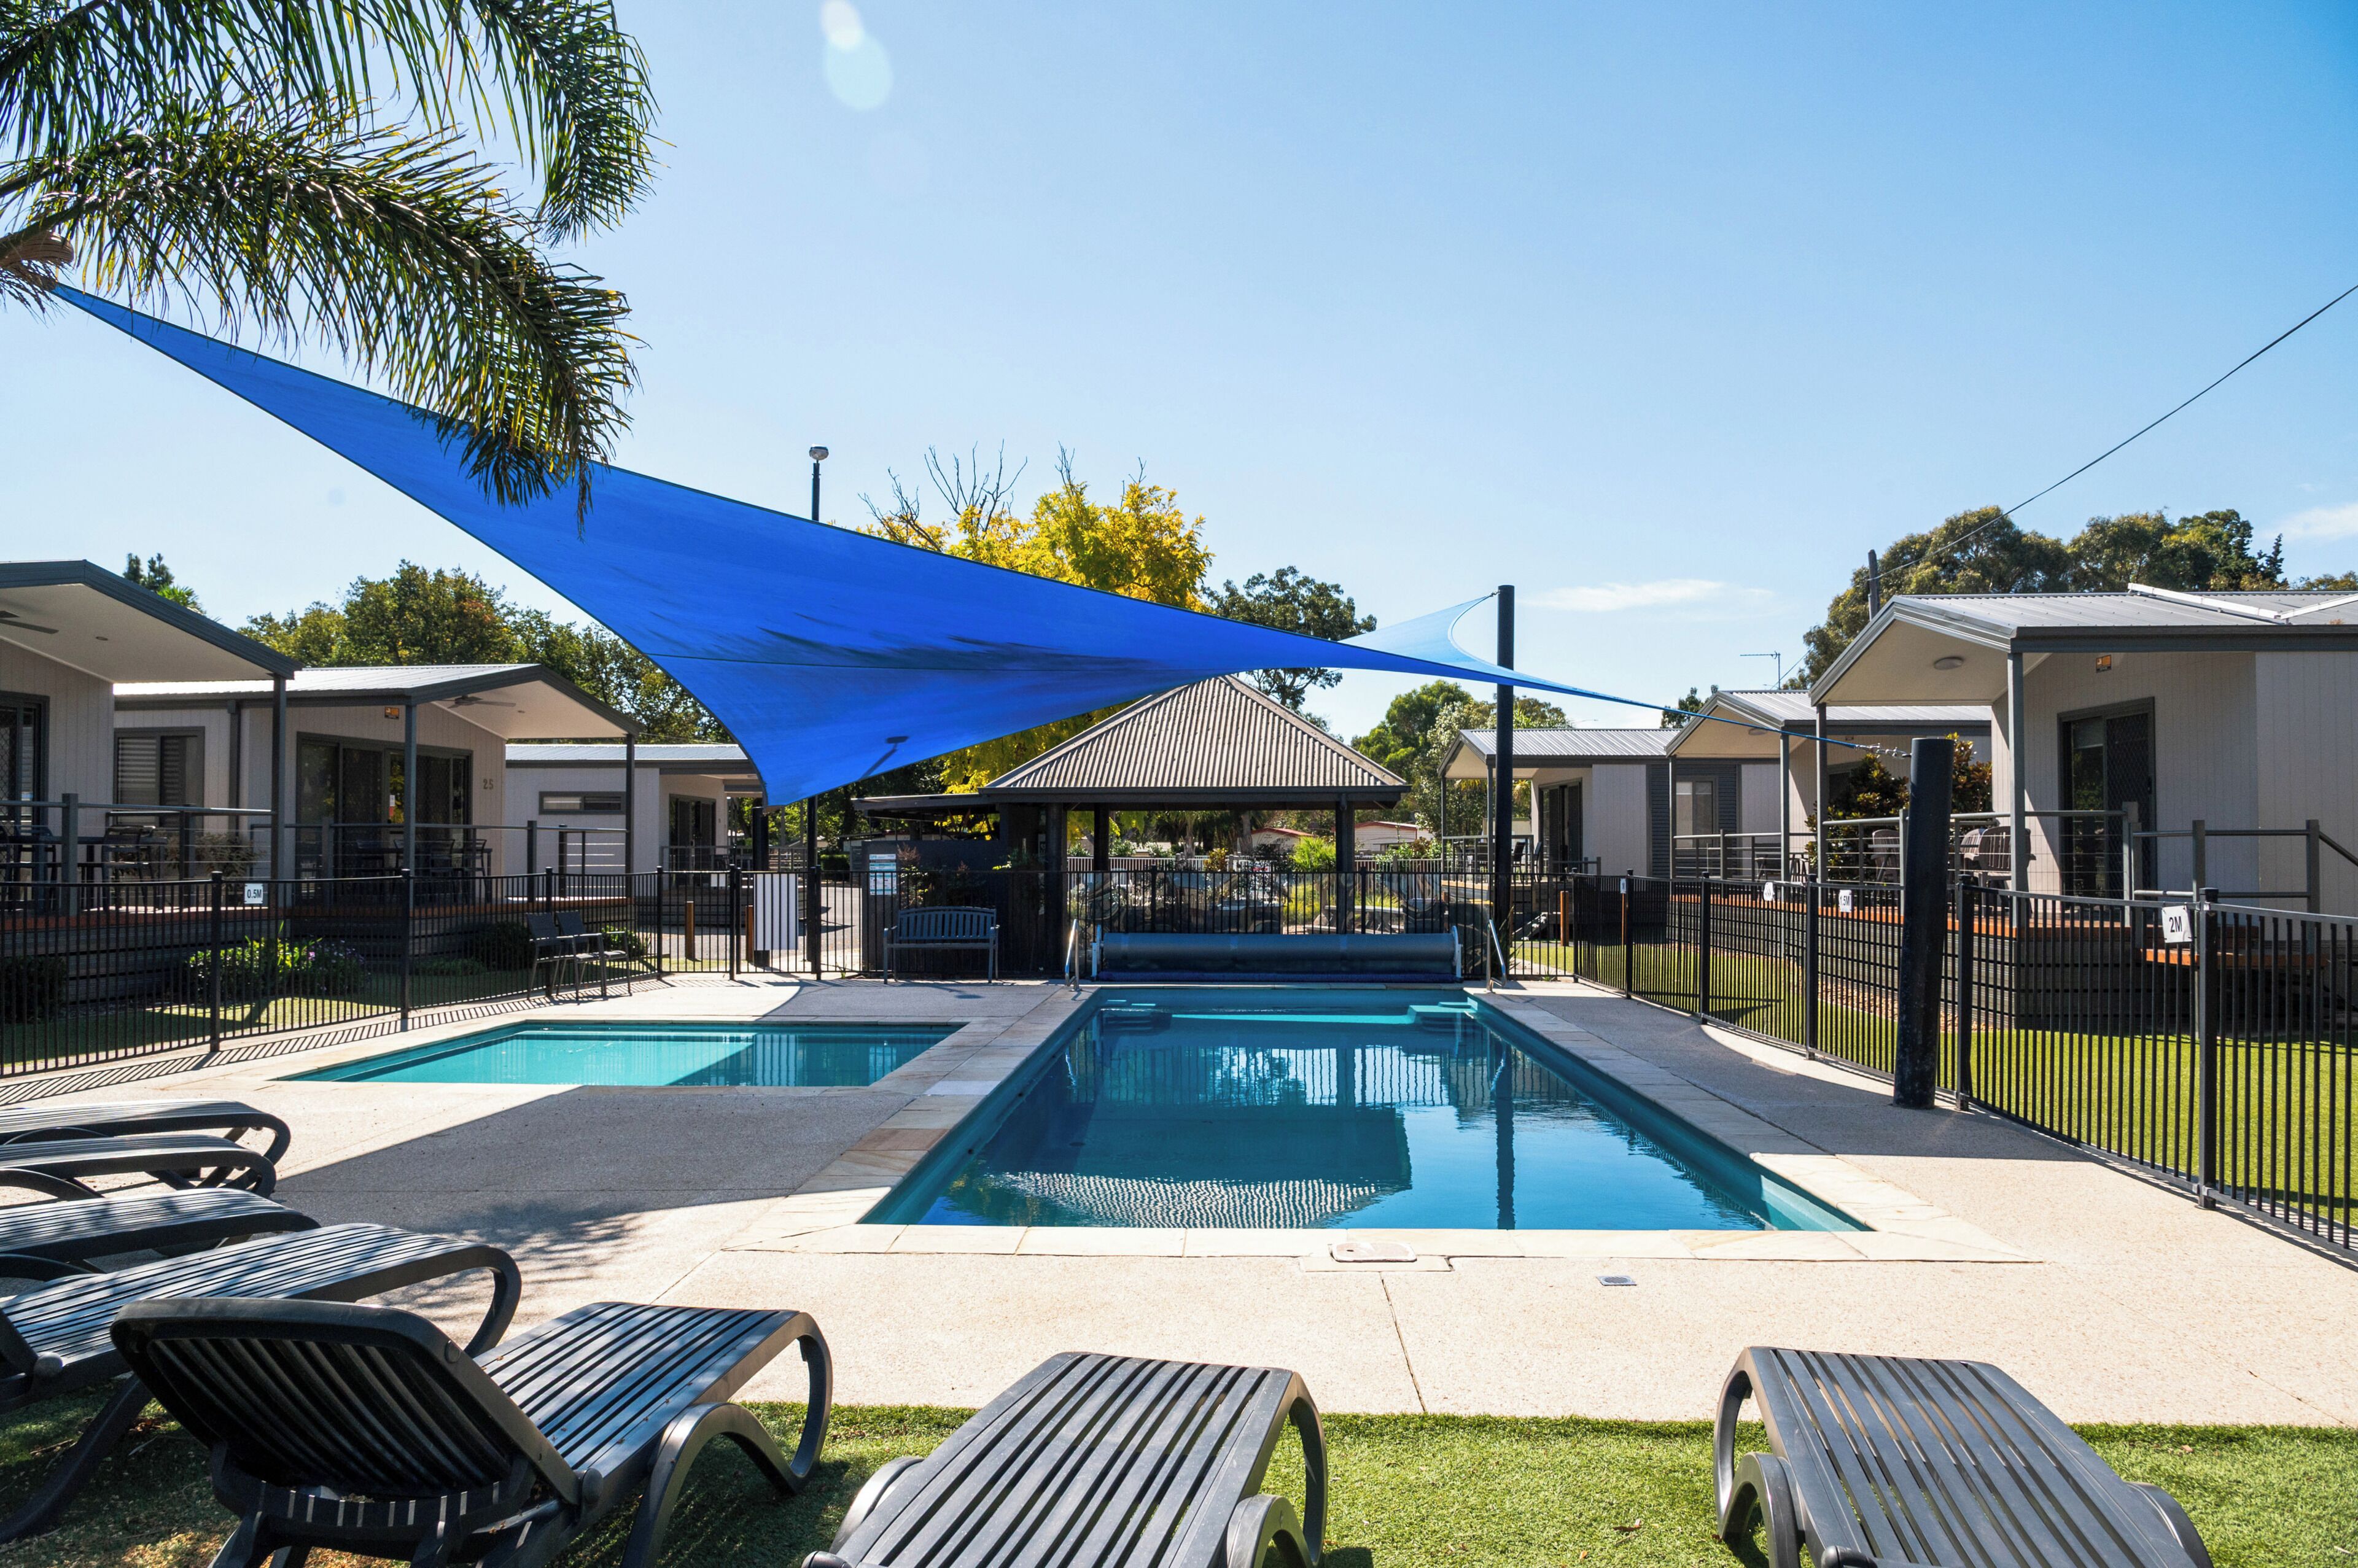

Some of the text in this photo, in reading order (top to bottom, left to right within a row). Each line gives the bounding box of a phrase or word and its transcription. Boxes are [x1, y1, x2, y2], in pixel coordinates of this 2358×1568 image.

[483, 778, 494, 790] 25
[247, 889, 262, 898] 0.5M
[2168, 915, 2183, 933] 2M
